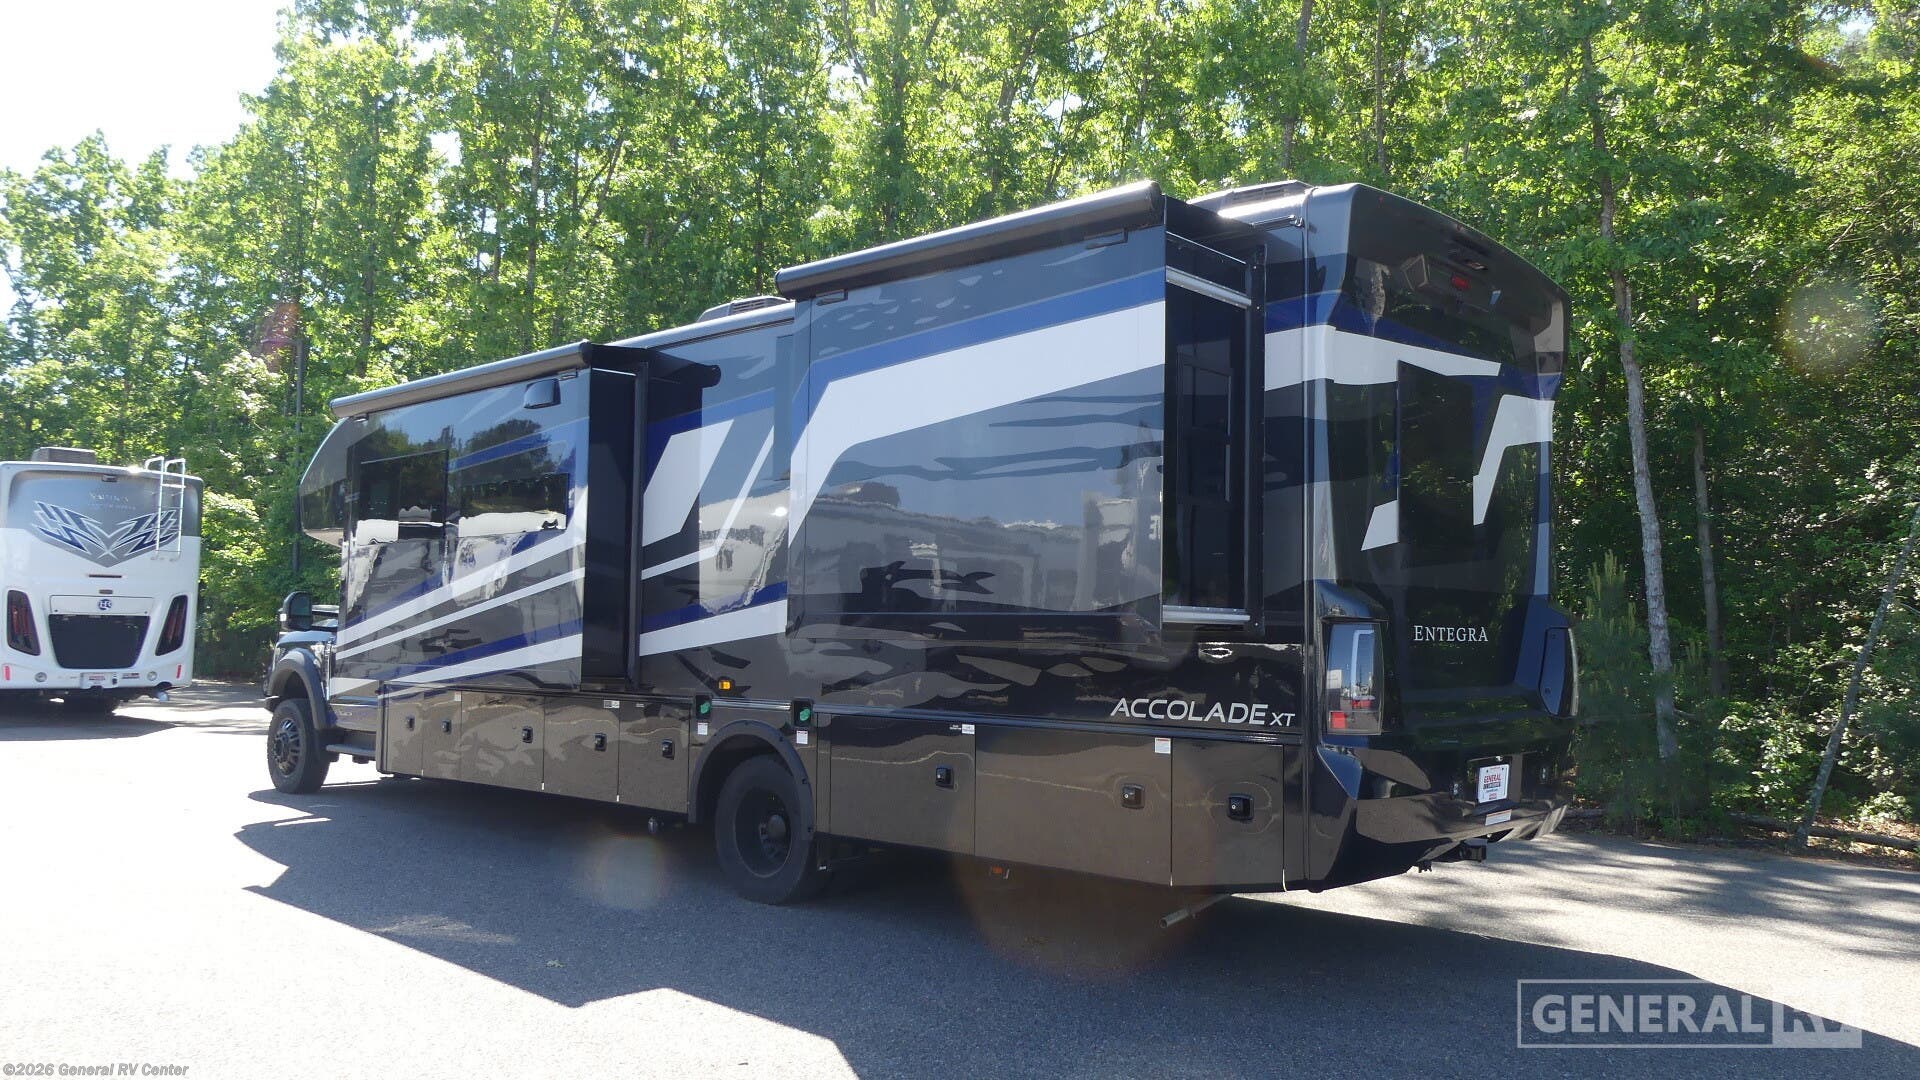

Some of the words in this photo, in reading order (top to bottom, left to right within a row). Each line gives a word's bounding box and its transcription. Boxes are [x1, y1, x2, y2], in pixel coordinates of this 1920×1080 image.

[1413, 625, 1489, 642] ENTEGRA
[1110, 697, 1269, 726] ACCOLADE
[1269, 712, 1296, 727] XT
